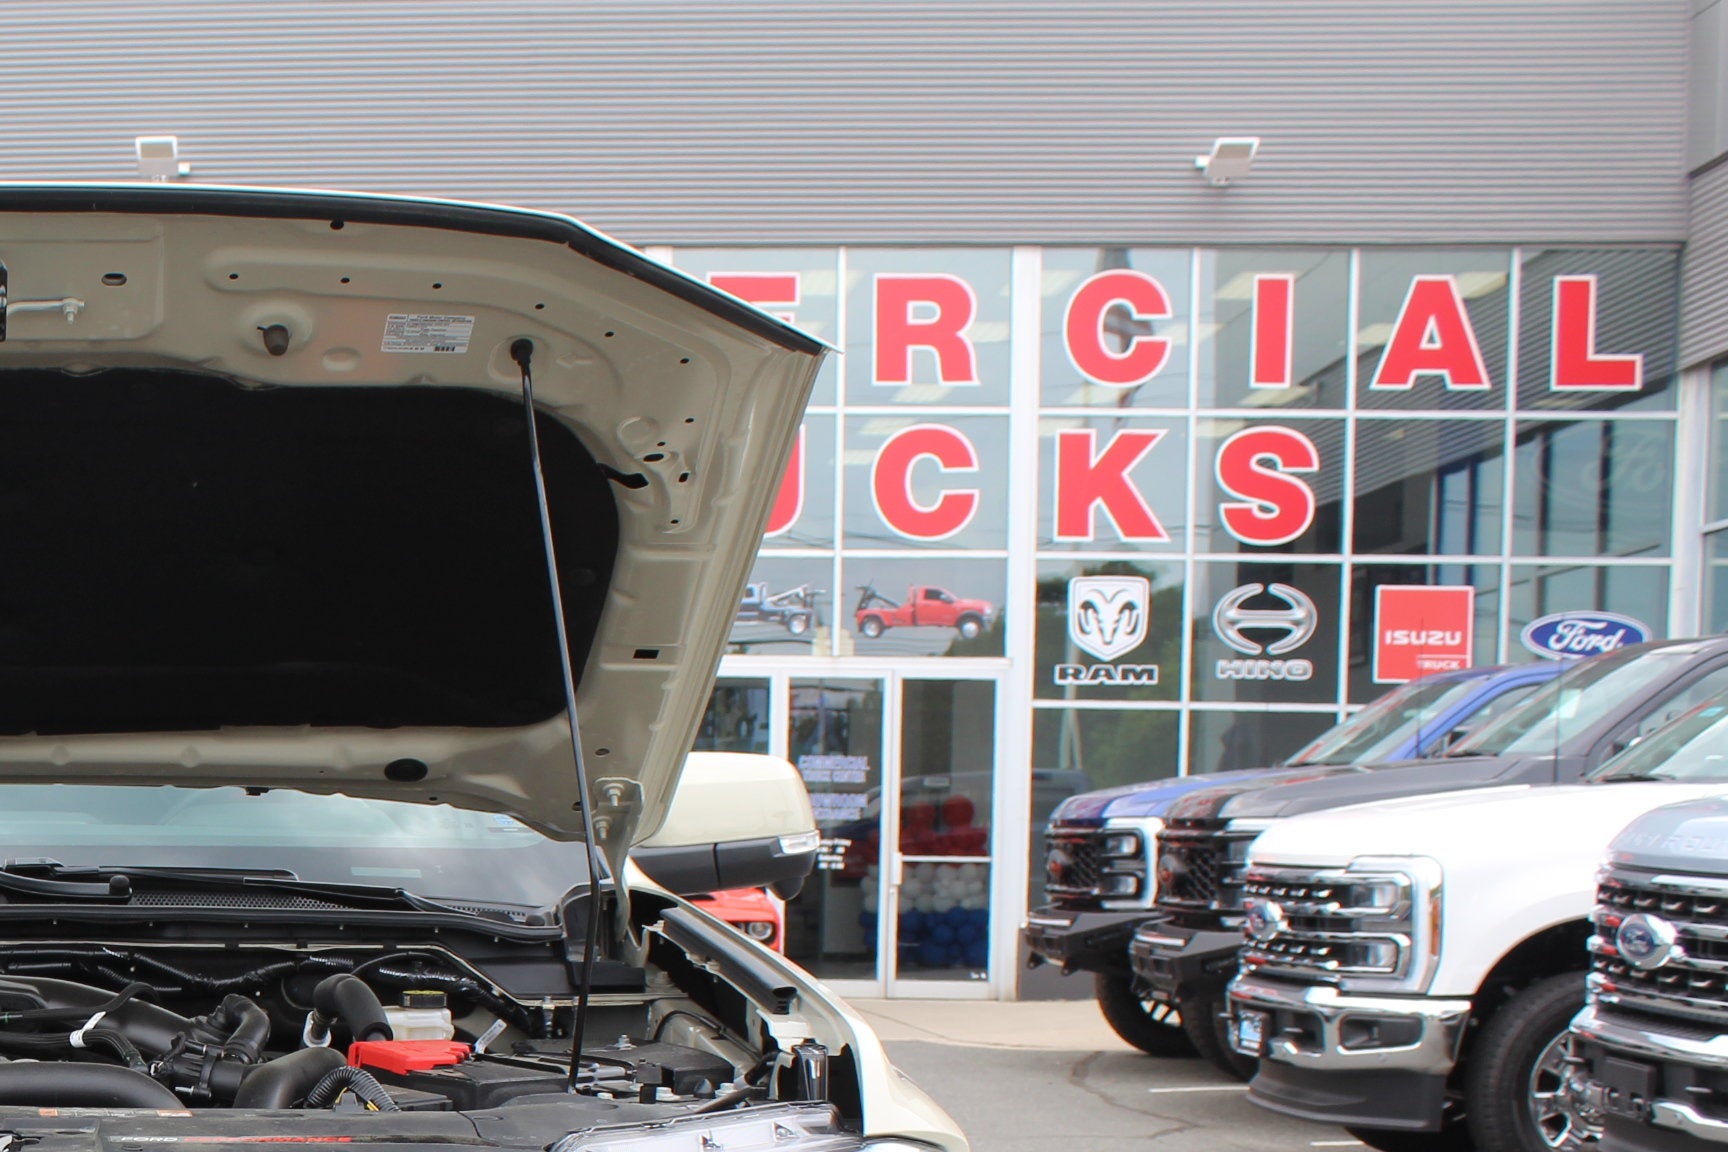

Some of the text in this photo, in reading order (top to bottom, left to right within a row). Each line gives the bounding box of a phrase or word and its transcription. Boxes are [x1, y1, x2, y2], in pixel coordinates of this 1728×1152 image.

[1384, 630, 1462, 646] ISUZU
[1548, 619, 1626, 653] Ford
[1054, 663, 1158, 685] RAM
[1215, 659, 1313, 681] HINO
[1417, 659, 1460, 670] TRUCK
